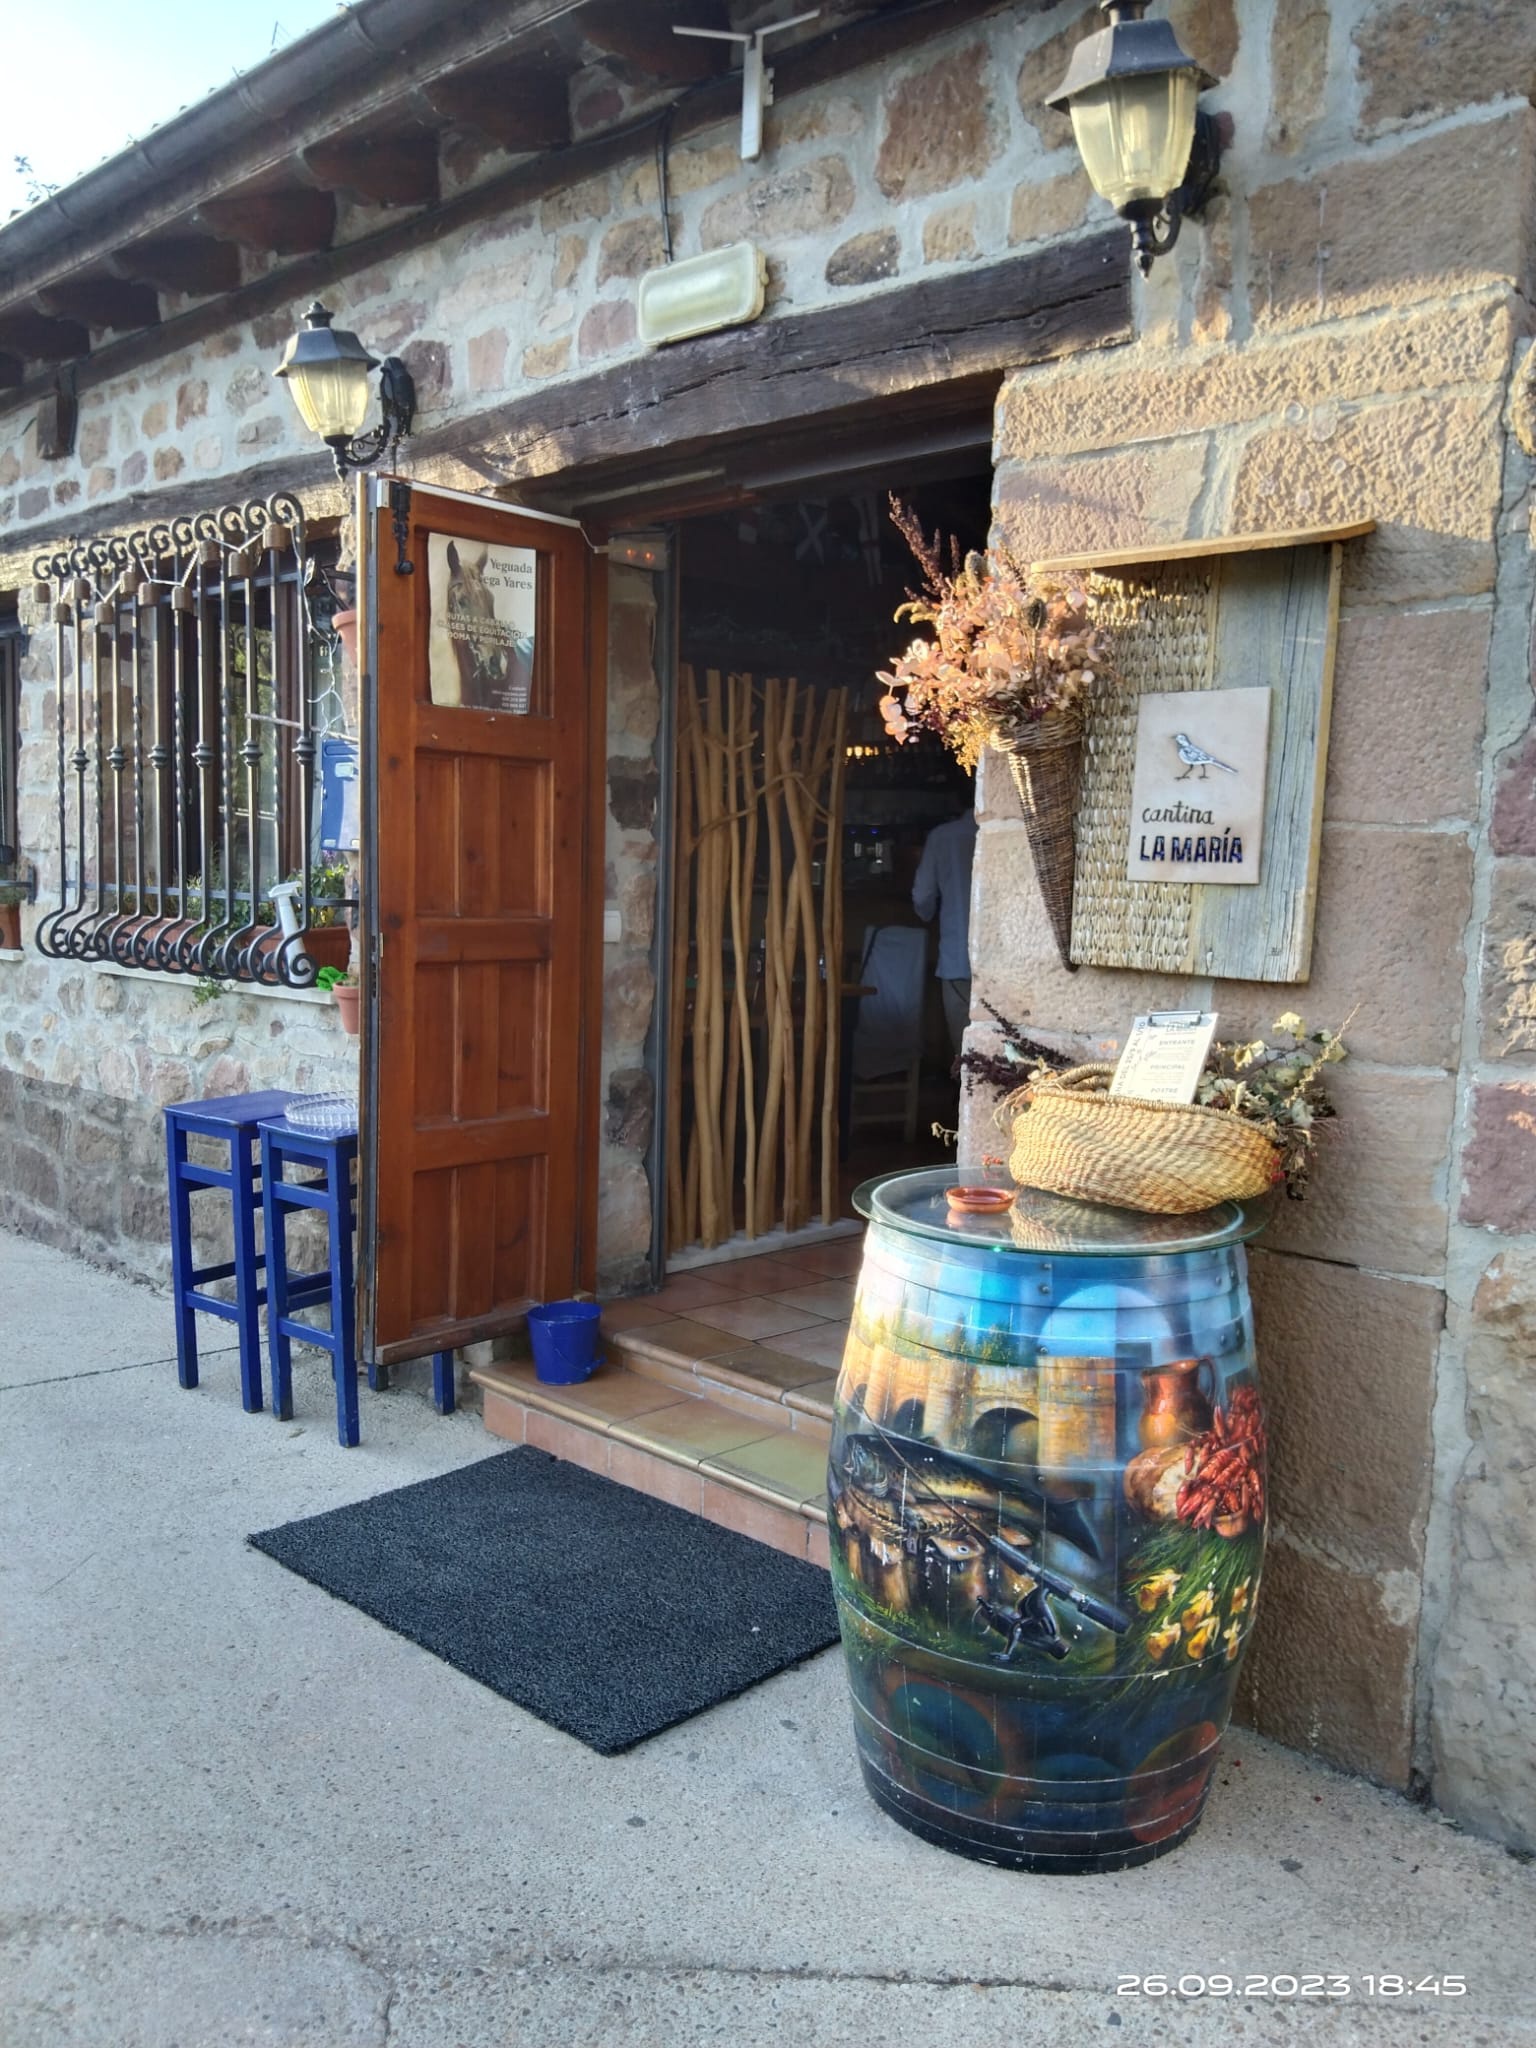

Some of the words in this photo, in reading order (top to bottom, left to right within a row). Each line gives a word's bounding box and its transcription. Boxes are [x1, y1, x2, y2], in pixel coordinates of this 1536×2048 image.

[490, 558, 533, 574] Yeguada
[503, 576, 533, 590] Yares
[1142, 800, 1215, 825] cantina
[1140, 835, 1166, 861] LA
[1171, 827, 1243, 863] MARÍA
